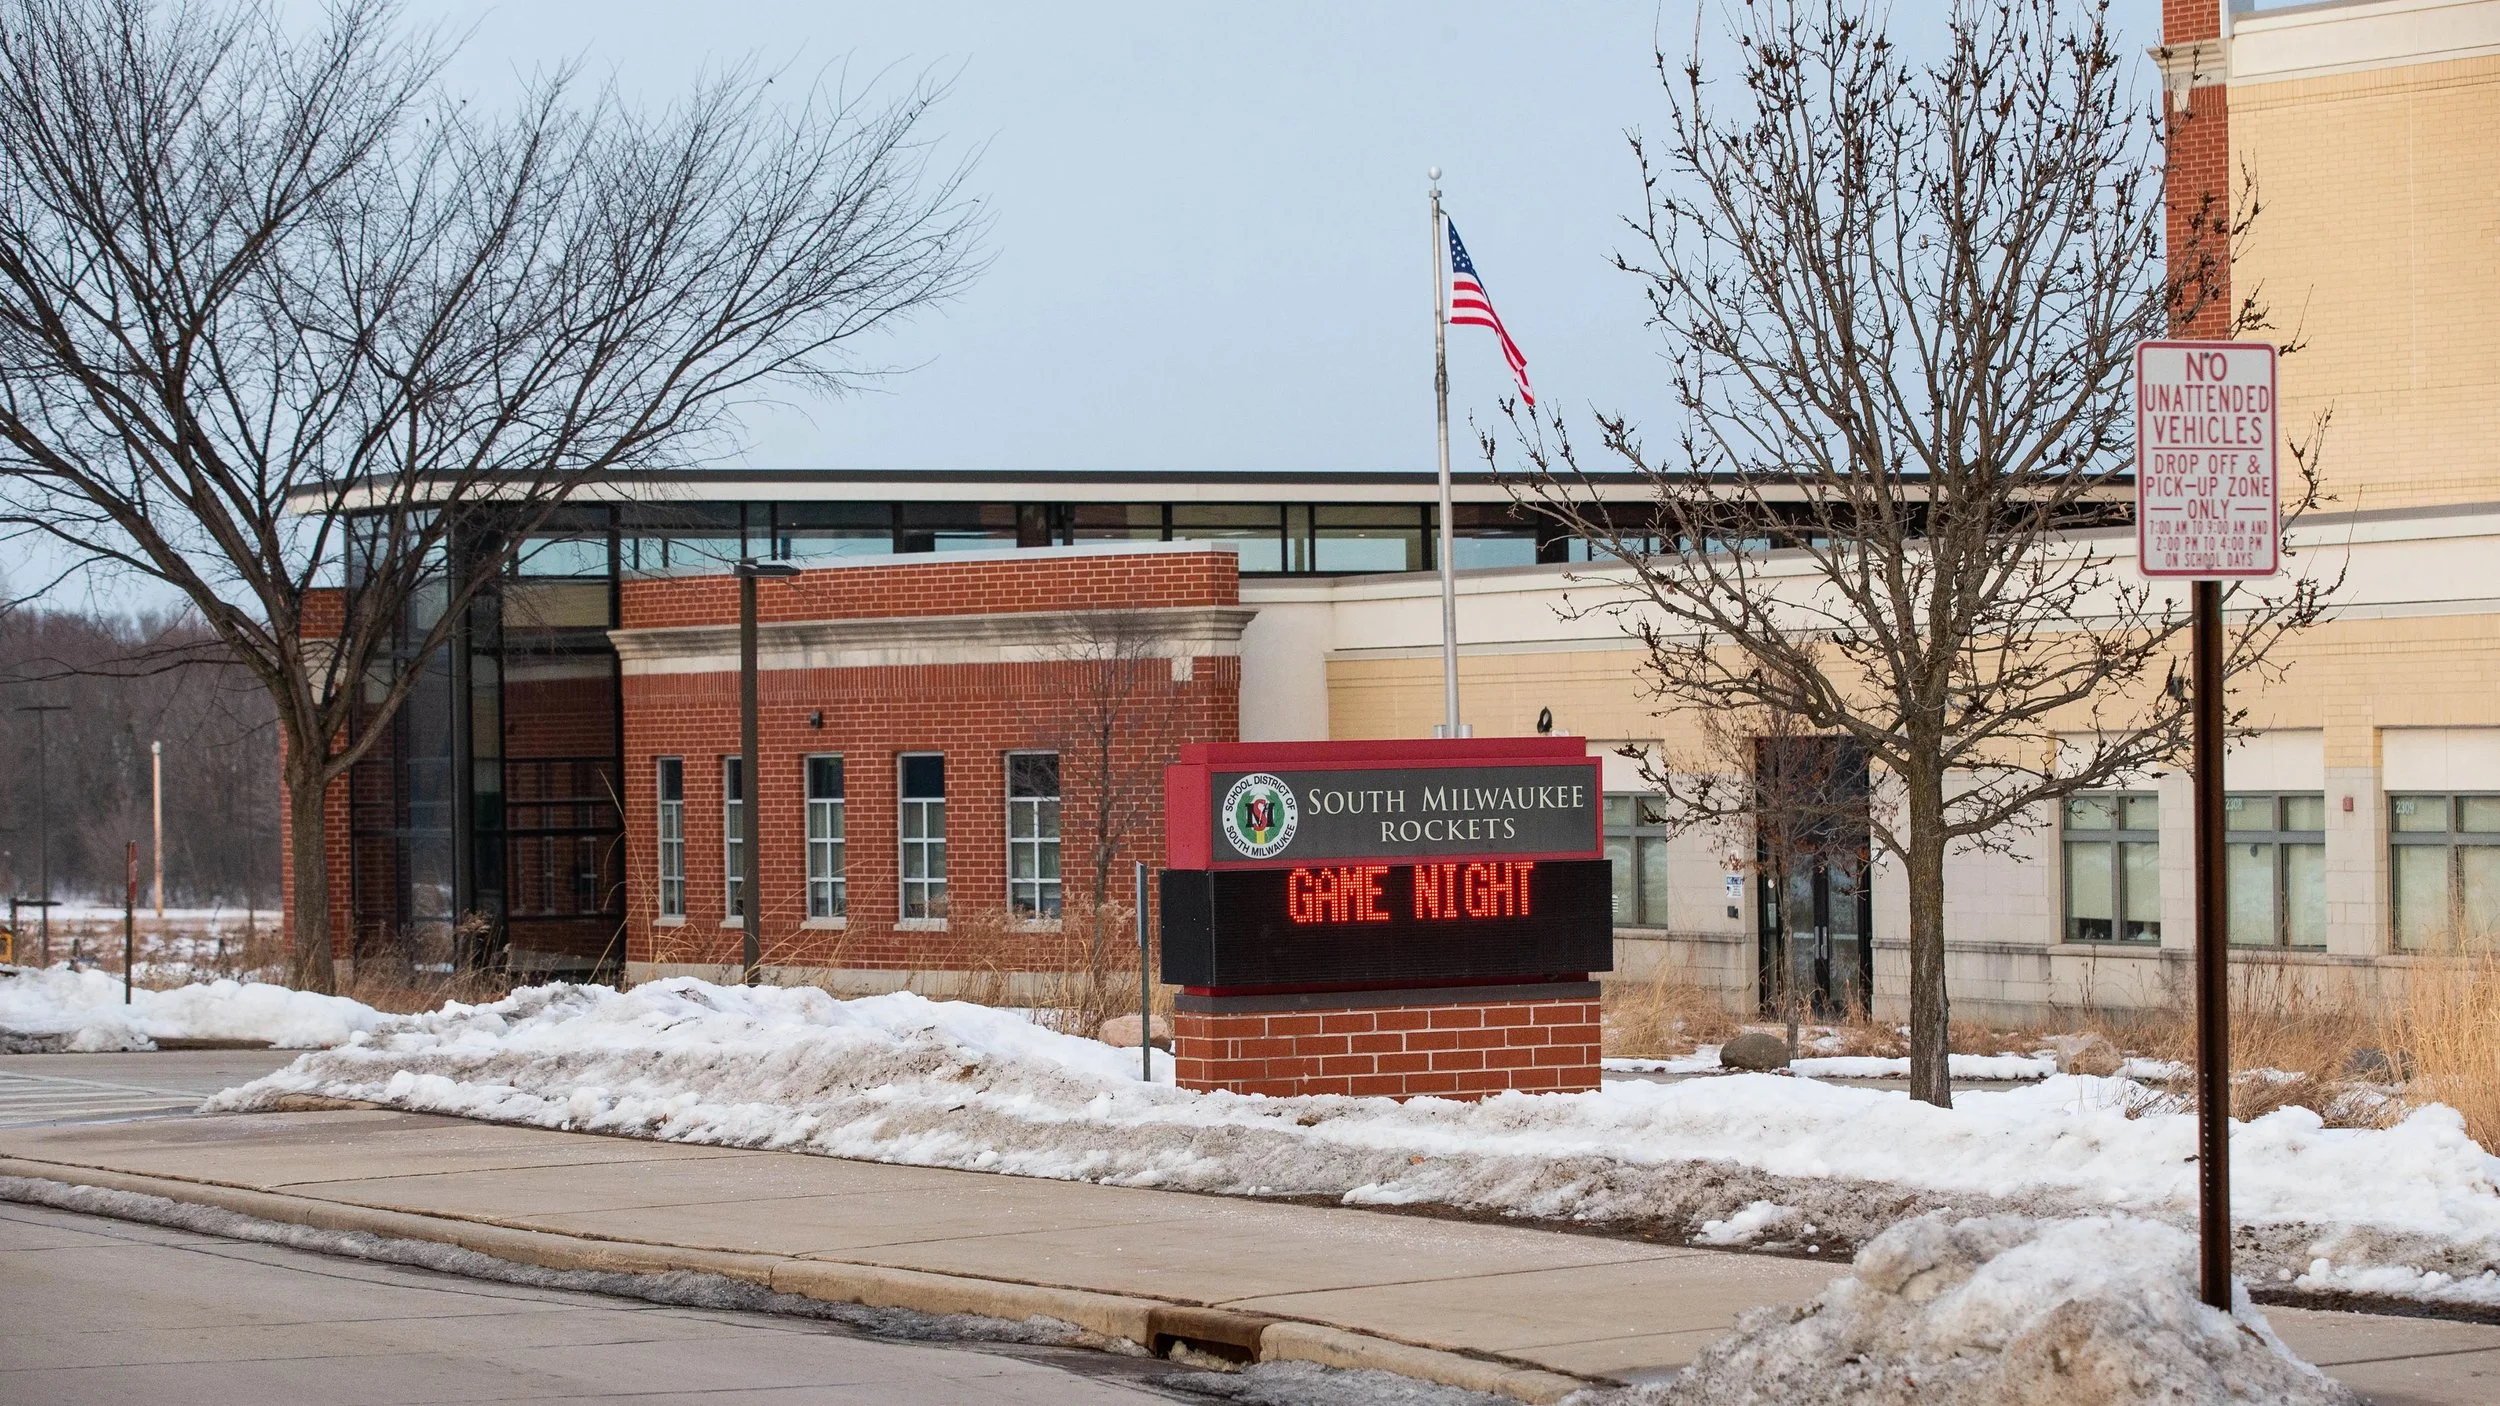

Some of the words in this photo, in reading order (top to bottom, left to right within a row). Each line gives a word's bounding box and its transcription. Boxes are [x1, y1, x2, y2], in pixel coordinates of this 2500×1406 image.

[2186, 352, 2227, 381] NO
[2144, 384, 2269, 413] UNATTENDED
[2153, 415, 2262, 444] VEHICLES
[2155, 454, 2199, 475] DROP
[2208, 454, 2239, 475] OFF
[2247, 455, 2261, 475] &
[2146, 476, 2218, 497] PICK-UP
[2228, 477, 2270, 497] ZONE
[2187, 499, 2230, 520] ONLY
[2149, 520, 2170, 535] 7:00
[2174, 520, 2187, 535] AM
[2192, 520, 2203, 535] TO
[2207, 520, 2229, 535] 9:00
[2233, 520, 2245, 535] AM
[2251, 520, 2268, 535] AND
[2156, 536, 2181, 551] 2:00
[2184, 537, 2198, 551] PM
[2204, 537, 2216, 551] TO
[2220, 537, 2246, 551] 4:00
[2249, 537, 2262, 551] PM
[2165, 553, 2179, 568] ON
[2184, 553, 2222, 568] SCHOOL
[2227, 553, 2254, 567] DAYS
[1225, 779, 1252, 812] SCHOOL
[1253, 775, 1290, 797] DISTRICT
[1286, 797, 1296, 811] OF
[1308, 788, 1406, 815] SOUTH
[1422, 785, 1584, 812] MILWAUKEE
[1226, 825, 1250, 853] SOUTH
[1251, 823, 1295, 857] MILWAUKEE
[1380, 817, 1516, 842] ROCKETS
[1288, 864, 1390, 924] GAME
[1413, 861, 1535, 920] NIGHT
